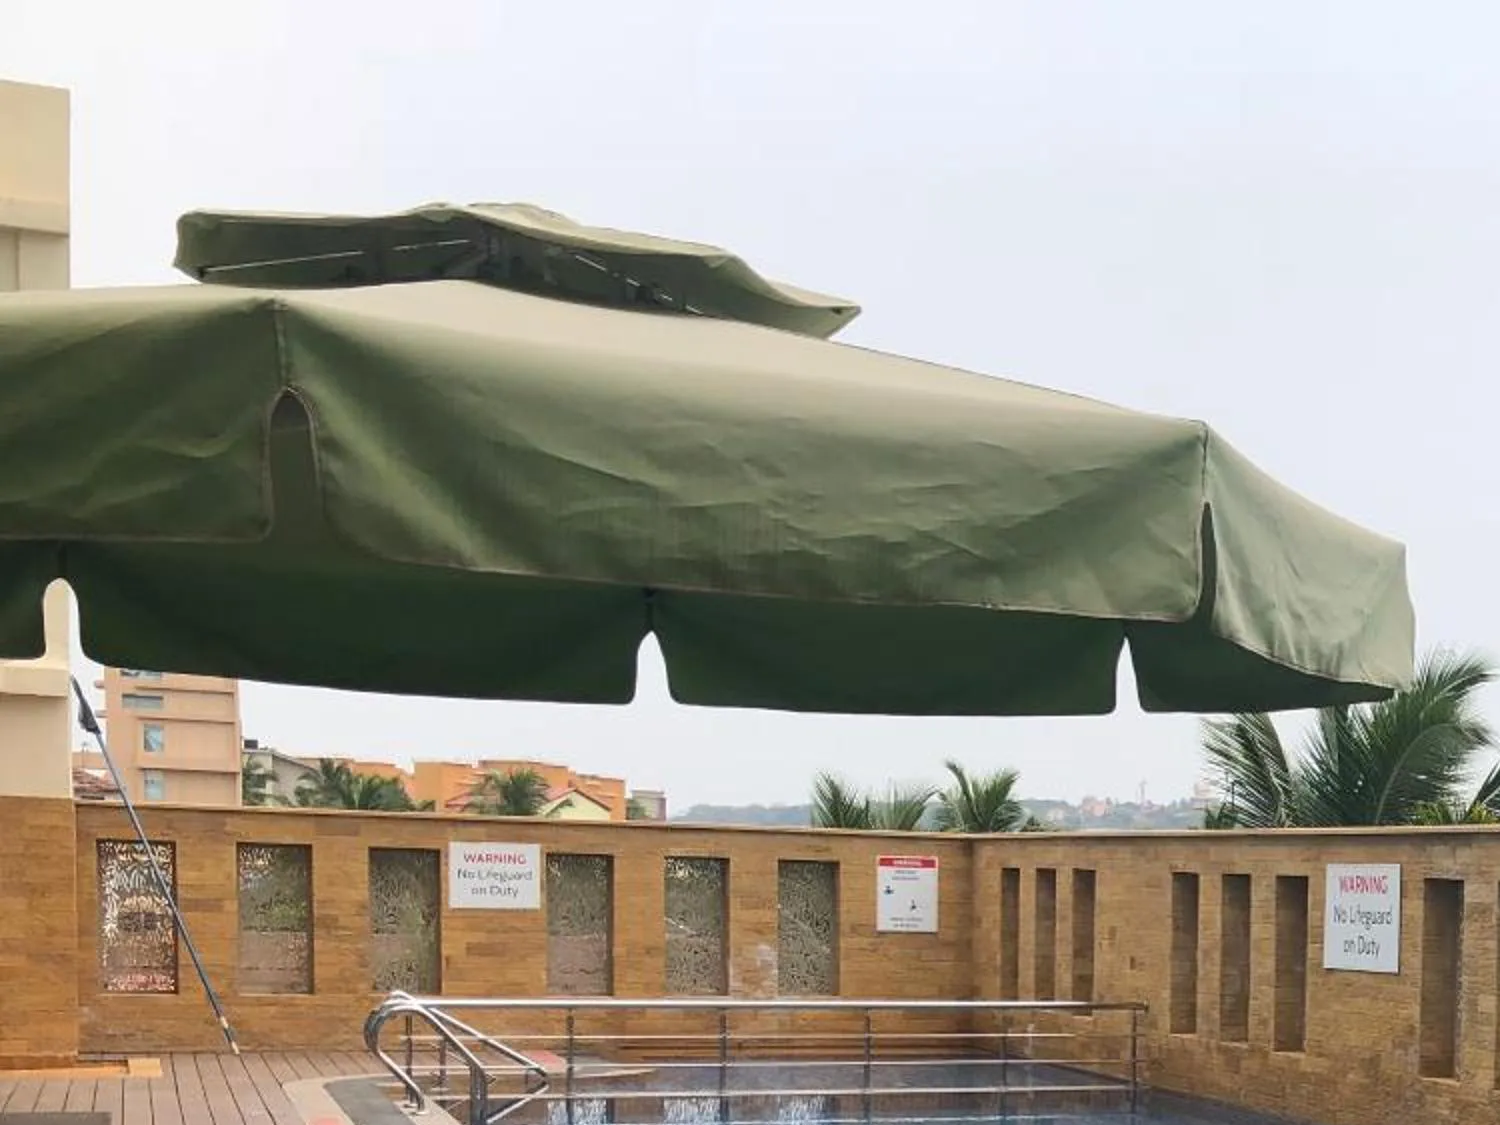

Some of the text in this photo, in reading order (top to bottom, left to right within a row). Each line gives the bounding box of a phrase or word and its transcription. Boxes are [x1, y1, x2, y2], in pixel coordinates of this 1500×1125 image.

[463, 852, 527, 866] WARNING
[457, 867, 533, 884] No Lifeguard
[1338, 874, 1388, 895] WARNING
[471, 884, 519, 899] on Duty
[1333, 903, 1393, 931] No Lifeguard
[1343, 935, 1380, 958] on Duty
